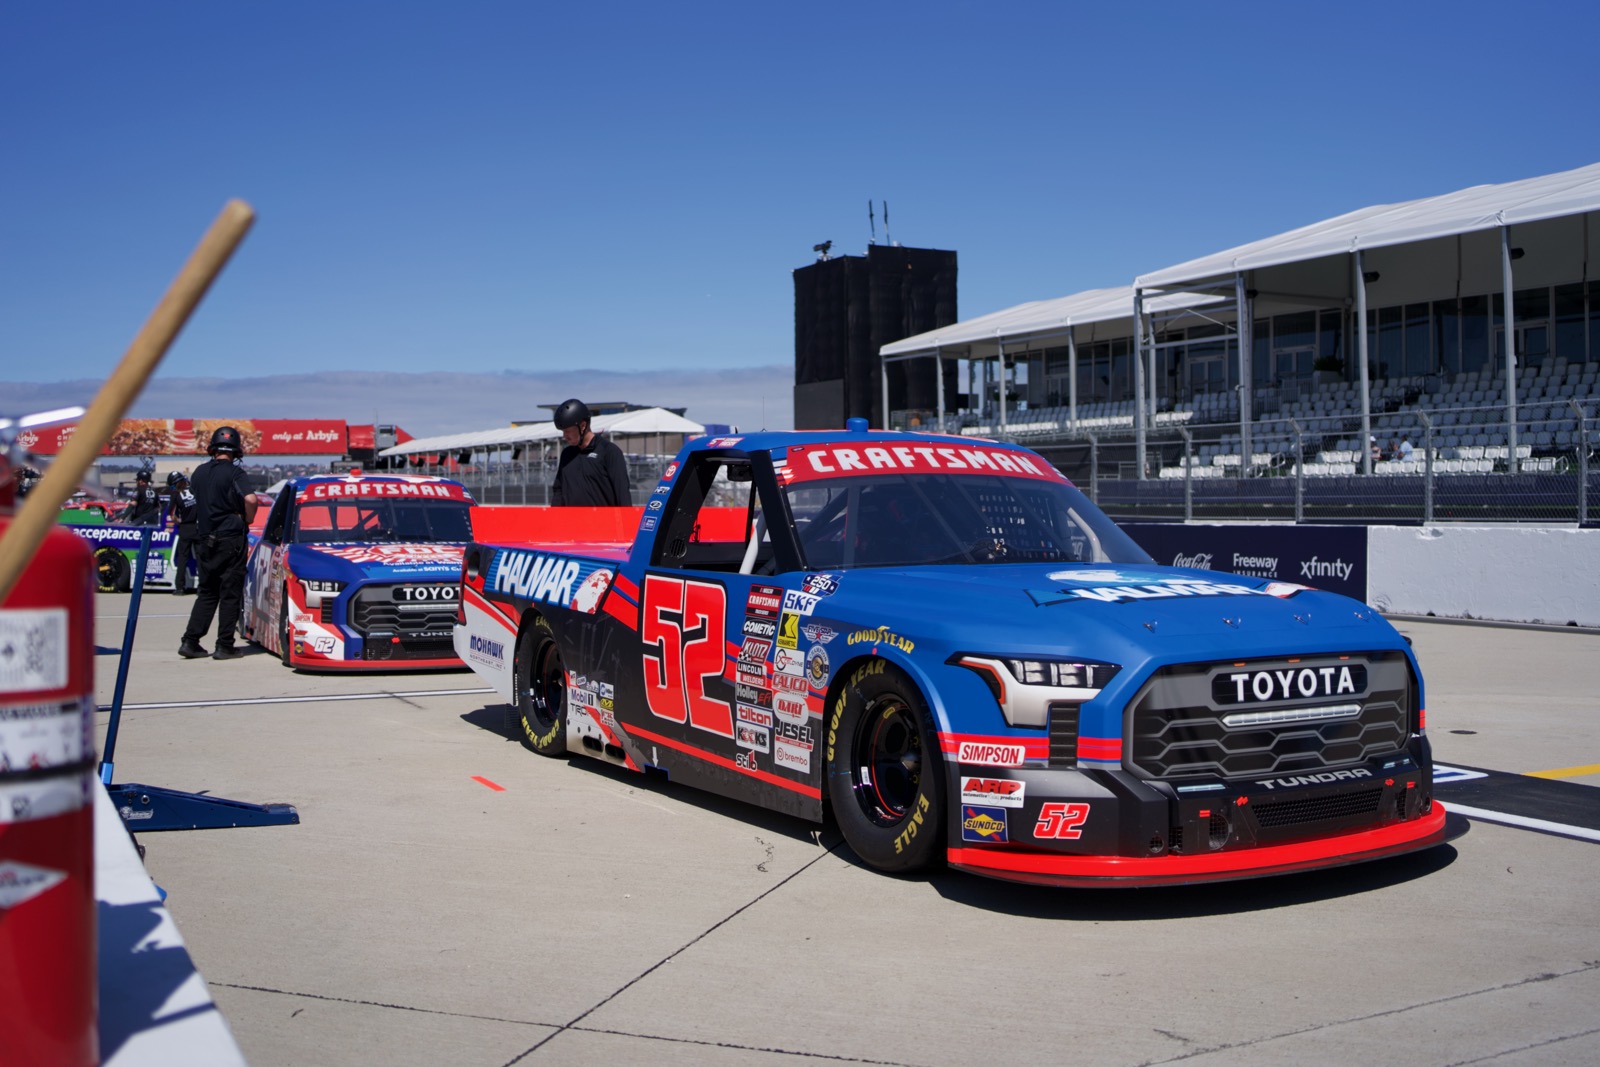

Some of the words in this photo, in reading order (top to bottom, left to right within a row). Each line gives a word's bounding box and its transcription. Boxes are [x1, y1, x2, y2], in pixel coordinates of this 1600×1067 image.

[272, 432, 292, 443] only
[293, 433, 303, 441] at
[306, 430, 339, 443] Arby's
[807, 447, 1044, 476] CRAFTSMAN
[314, 483, 450, 497] CRAFTSMAN
[73, 528, 170, 541] acceptance.om
[1233, 552, 1278, 571] Freeway
[1301, 556, 1353, 581] xfinity
[494, 551, 580, 606] HALMAR
[810, 576, 832, 591] 250
[1233, 570, 1278, 578] INSURANCE
[748, 595, 780, 608] CRAFTSMAN
[784, 592, 815, 612] SKF
[743, 621, 776, 637] COMETIC
[314, 636, 336, 654] 62
[470, 635, 504, 660] MOHAWK
[847, 625, 915, 655] GOODYEAR
[642, 574, 735, 740] 52
[742, 640, 769, 660] KLOTZ
[737, 663, 763, 675] LINCOLN
[742, 675, 765, 687] WELDERS
[773, 674, 809, 693] CALICO
[1231, 666, 1356, 702] TOYOTA
[571, 688, 588, 703] Mobil
[736, 685, 759, 704] Holley
[739, 706, 772, 725] tilton
[737, 726, 767, 747] KOOKS
[776, 722, 814, 745] JESEL
[784, 751, 808, 766] brembo
[961, 744, 1020, 764] SIMPSON
[963, 778, 1022, 795] ARP
[1256, 768, 1373, 789] TUNDRA
[894, 793, 930, 855] EAGLE
[966, 819, 1003, 832] SUNOCO
[1033, 802, 1090, 839] 52
